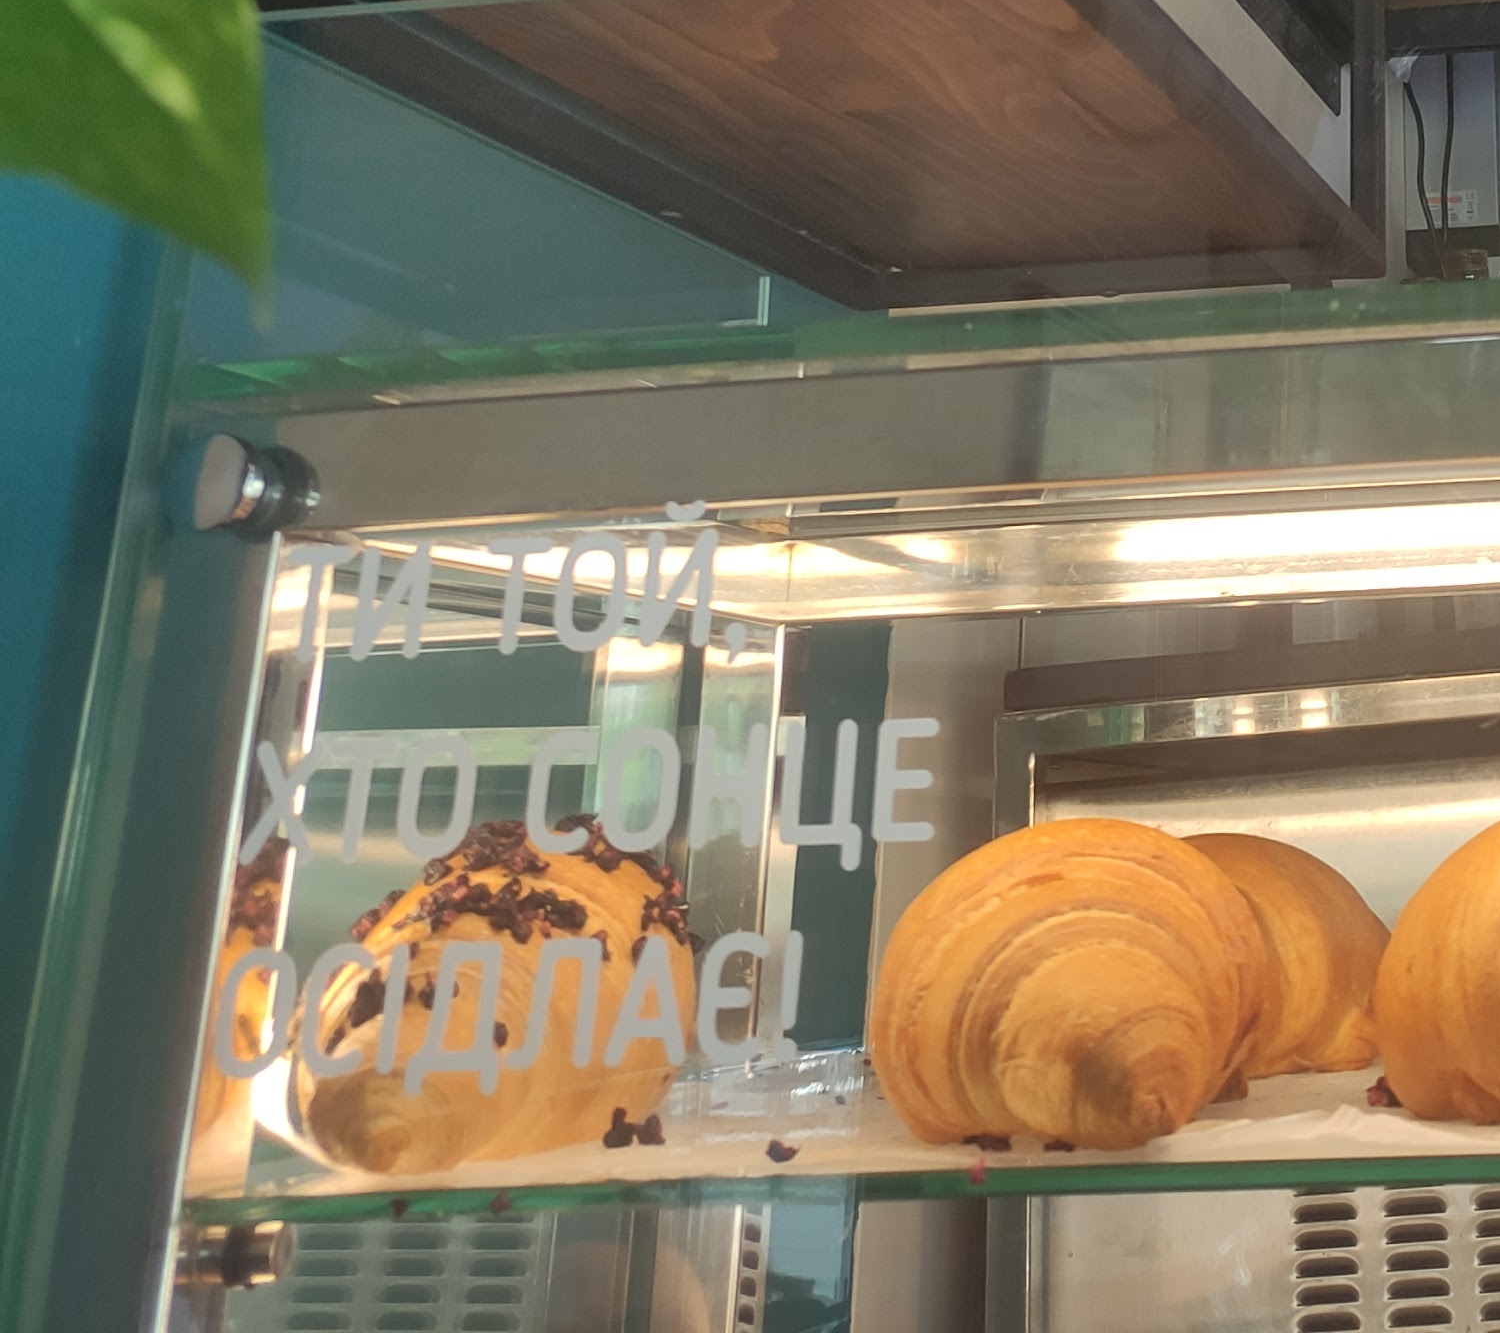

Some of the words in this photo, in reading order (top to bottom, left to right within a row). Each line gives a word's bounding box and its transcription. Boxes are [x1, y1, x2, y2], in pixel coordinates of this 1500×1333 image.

[289, 542, 433, 664] ТИ
[485, 500, 749, 665] ТОЙ,
[237, 737, 478, 869] ХТО
[525, 716, 942, 873] СОНЦЕ
[213, 929, 807, 1098] ОСІДЛАЄ!
